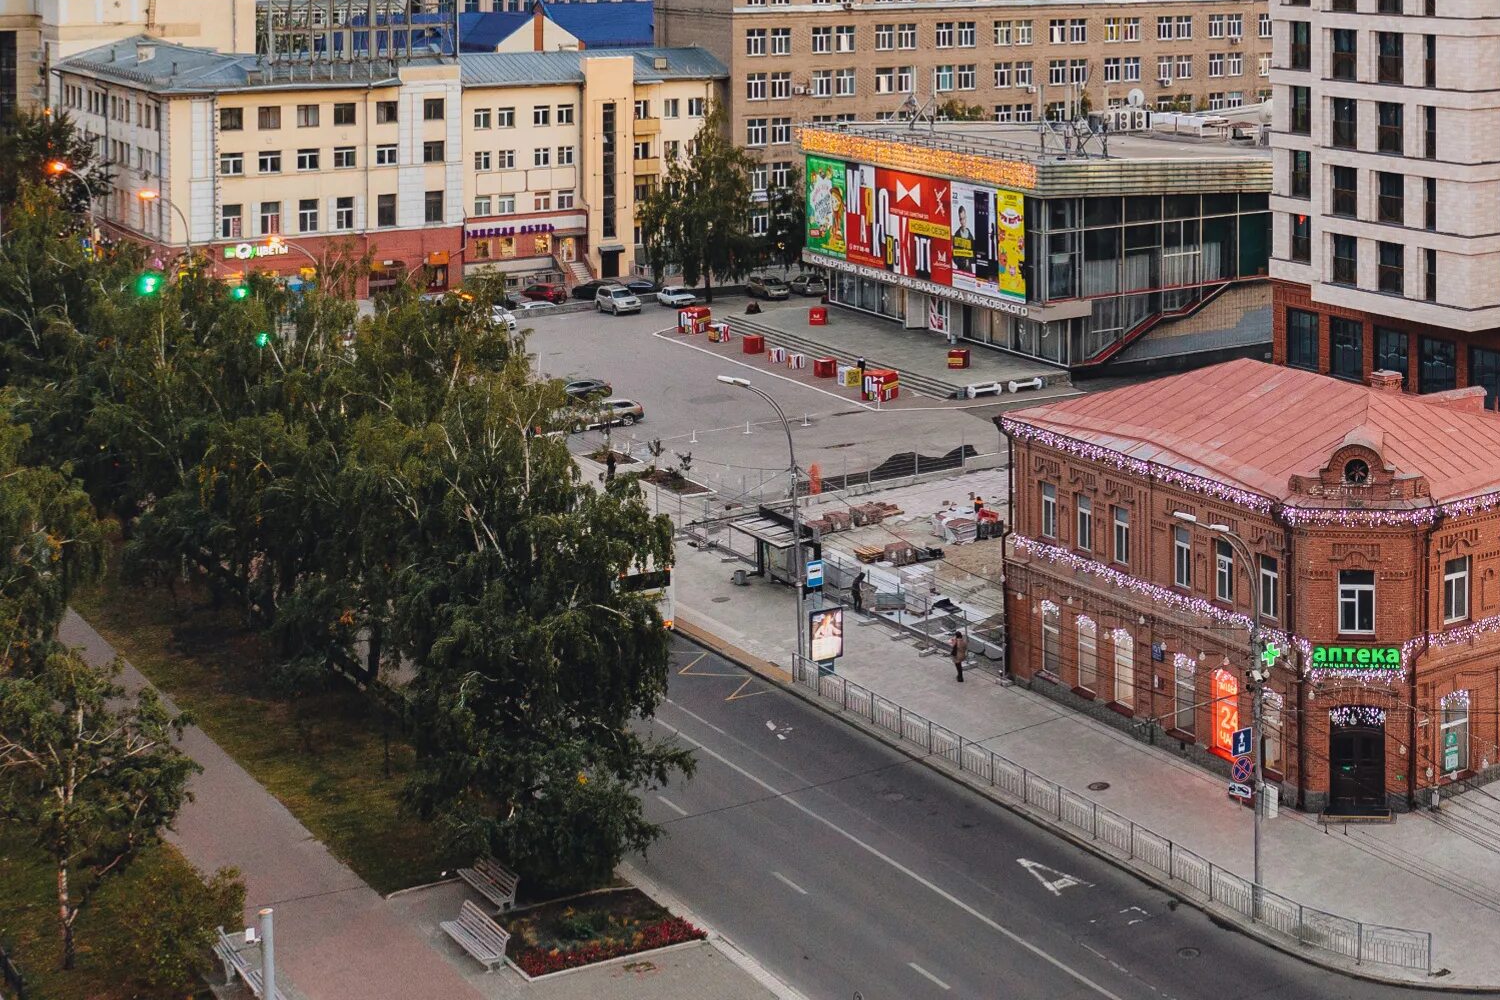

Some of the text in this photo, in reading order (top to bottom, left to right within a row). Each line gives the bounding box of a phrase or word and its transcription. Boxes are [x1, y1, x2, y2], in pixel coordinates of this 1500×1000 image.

[256, 244, 289, 257] ЦВЕТЫ
[811, 254, 857, 274] КОНЦЕРТНЫЙ
[859, 266, 898, 284] КОМПЛЕКС
[915, 280, 965, 301] ВЛАДИМИРА
[966, 293, 1028, 316] МАЯКОВСКОГО
[1313, 646, 1400, 663] аптека
[1221, 706, 1239, 734] 24
